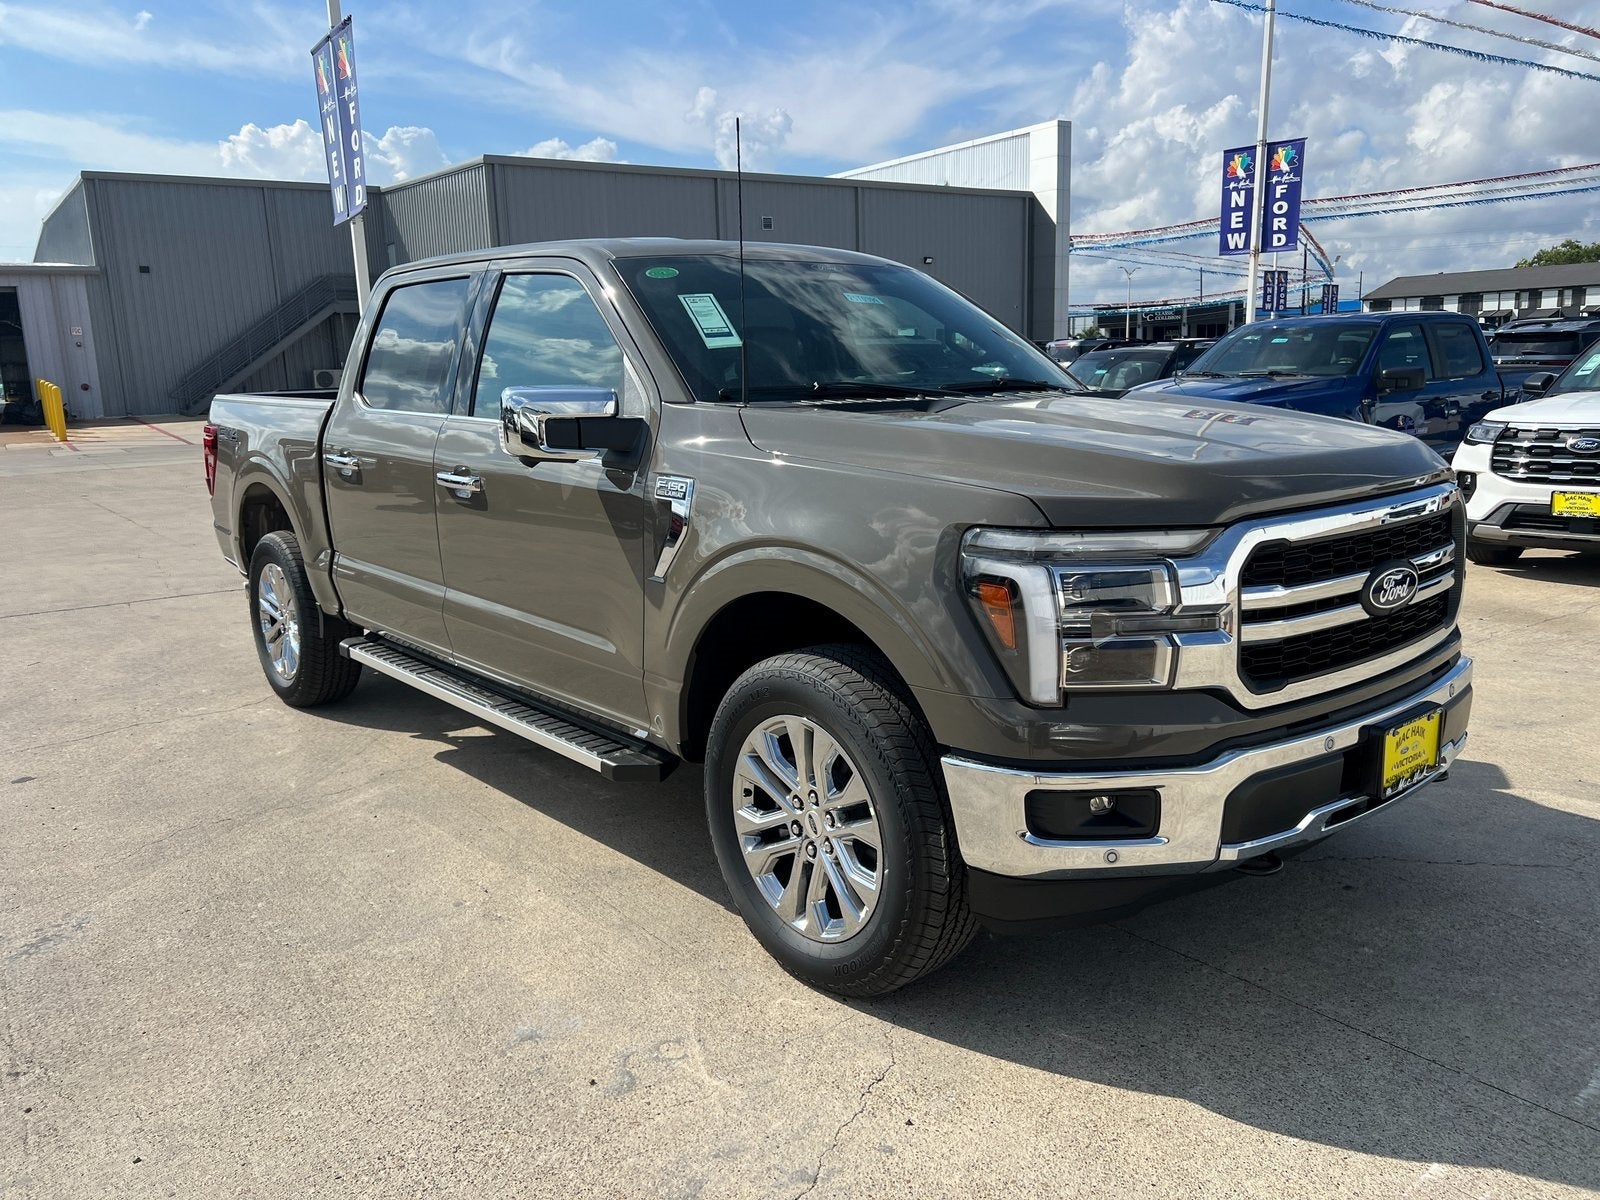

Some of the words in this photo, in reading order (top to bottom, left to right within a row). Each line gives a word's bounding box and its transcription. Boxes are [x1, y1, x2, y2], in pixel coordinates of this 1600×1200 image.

[326, 114, 344, 214] NEW
[348, 102, 363, 206] FORD
[1227, 190, 1246, 250] NEW
[1272, 184, 1289, 247] FORD
[1264, 286, 1273, 311] NEW
[1278, 286, 1286, 311] FORD
[1575, 440, 1598, 450] Ford
[657, 480, 687, 492] F-150
[1379, 573, 1410, 603] Ford
[1394, 728, 1410, 752] MAC
